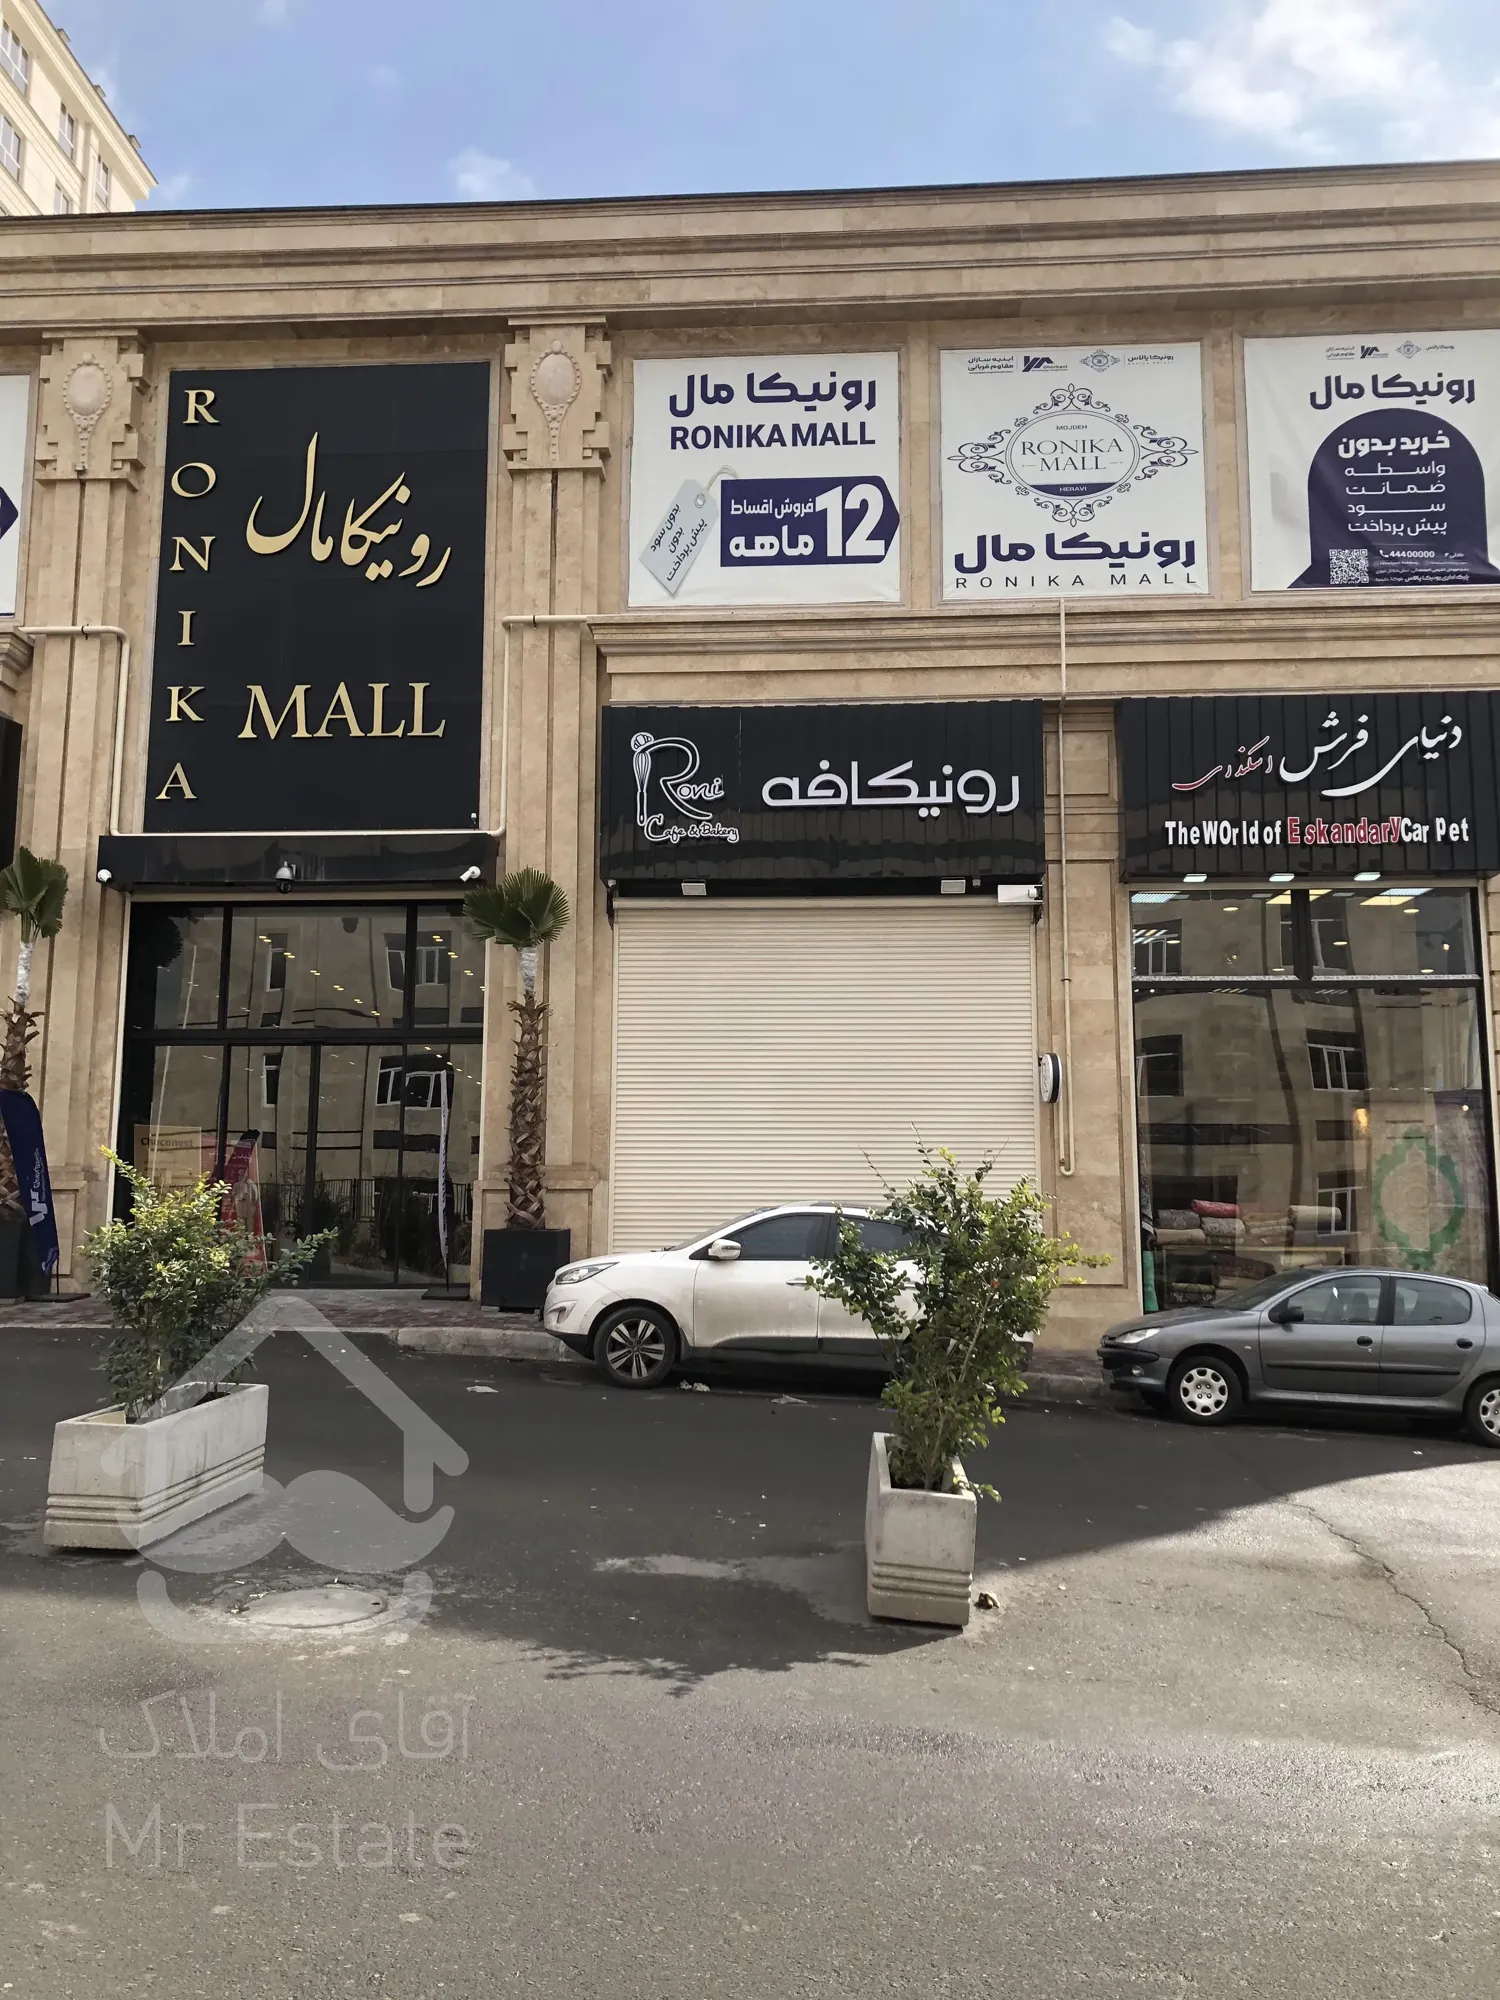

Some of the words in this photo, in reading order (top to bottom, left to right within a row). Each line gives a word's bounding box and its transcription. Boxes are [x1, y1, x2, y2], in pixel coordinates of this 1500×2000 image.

[1127, 354, 1149, 362] پالاس
[669, 374, 735, 418] مال
[746, 371, 877, 412] رونیکا
[1309, 374, 1365, 410] مال
[1371, 372, 1476, 404] رونیکا
[670, 423, 786, 450] RONIKA
[792, 421, 876, 447] MALL
[1021, 437, 1123, 456] RONIKA
[1338, 436, 1396, 459] بدون
[1400, 430, 1450, 454] خرید
[1040, 456, 1106, 472] MALL
[1344, 460, 1446, 477] واسطه
[246, 432, 334, 562] مال
[1059, 485, 1088, 493] HERAVI
[1346, 480, 1446, 495] ضمانت
[664, 503, 681, 531] بدون
[731, 498, 773, 515] اقساط
[775, 498, 814, 519] فروش
[815, 484, 886, 557] 12
[1347, 501, 1446, 516] سود
[341, 472, 451, 587] رونیکا
[650, 527, 666, 552] سود
[668, 526, 685, 554] بدون
[690, 518, 708, 547] پیش
[729, 525, 815, 557] ماهه
[1348, 519, 1404, 536] پرداخت
[1407, 518, 1447, 536] پیش
[666, 544, 693, 581] پرداخت
[954, 533, 1035, 574] مال
[1046, 531, 1195, 568] رونیکا
[1389, 550, 1435, 558] 44400000
[956, 575, 1084, 588] RONIKA
[1111, 573, 1197, 585] MALL
[238, 681, 446, 740] MALL
[1279, 711, 1369, 783] فرش
[1321, 715, 1463, 797] دنیای
[632, 736, 724, 823] Roni
[644, 813, 686, 843] Cafe
[688, 824, 700, 837] &
[699, 822, 740, 843] Bakery
[1165, 820, 1201, 845] The
[1263, 821, 1281, 844] of
